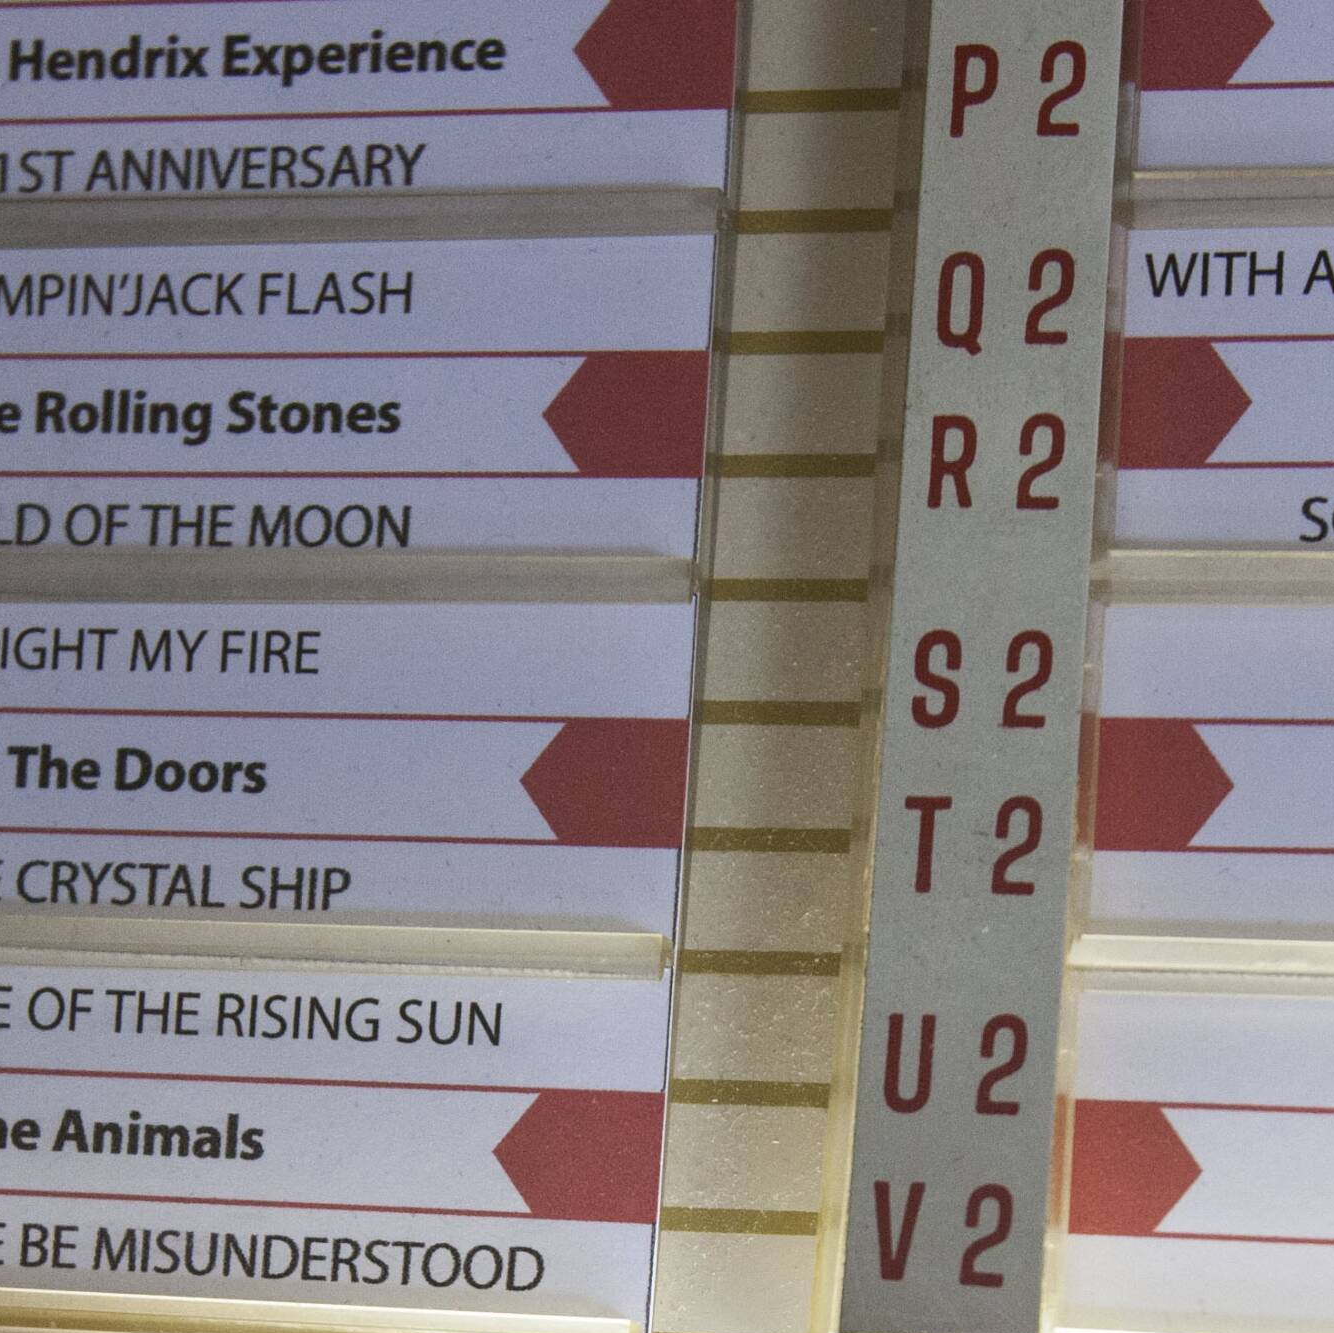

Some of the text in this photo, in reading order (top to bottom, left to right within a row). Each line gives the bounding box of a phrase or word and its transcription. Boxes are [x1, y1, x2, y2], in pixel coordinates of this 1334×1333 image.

[8, 34, 208, 82] Hendrix
[222, 29, 506, 88] Experience
[85, 144, 426, 192] ANNIVERSARY
[258, 271, 413, 315] FLASH
[1145, 251, 1285, 298] WITH
[35, 389, 212, 445] Rolling
[227, 391, 401, 434] Stones
[65, 503, 129, 547] OF
[141, 503, 233, 547] THE
[248, 504, 411, 548] MOON
[129, 629, 207, 672] MY
[220, 630, 320, 674] FIRE
[7, 744, 266, 794] The Doors
[16, 860, 225, 909] CRYSTAL
[239, 865, 351, 911] SHIP
[27, 986, 94, 1031] OF
[106, 989, 200, 1036] THE
[216, 993, 379, 1042] RISING
[397, 999, 502, 1046] SUN
[52, 1109, 263, 1160] Animals
[19, 1223, 78, 1270] BE
[92, 1227, 544, 1291] MISUNDERSTOOD
